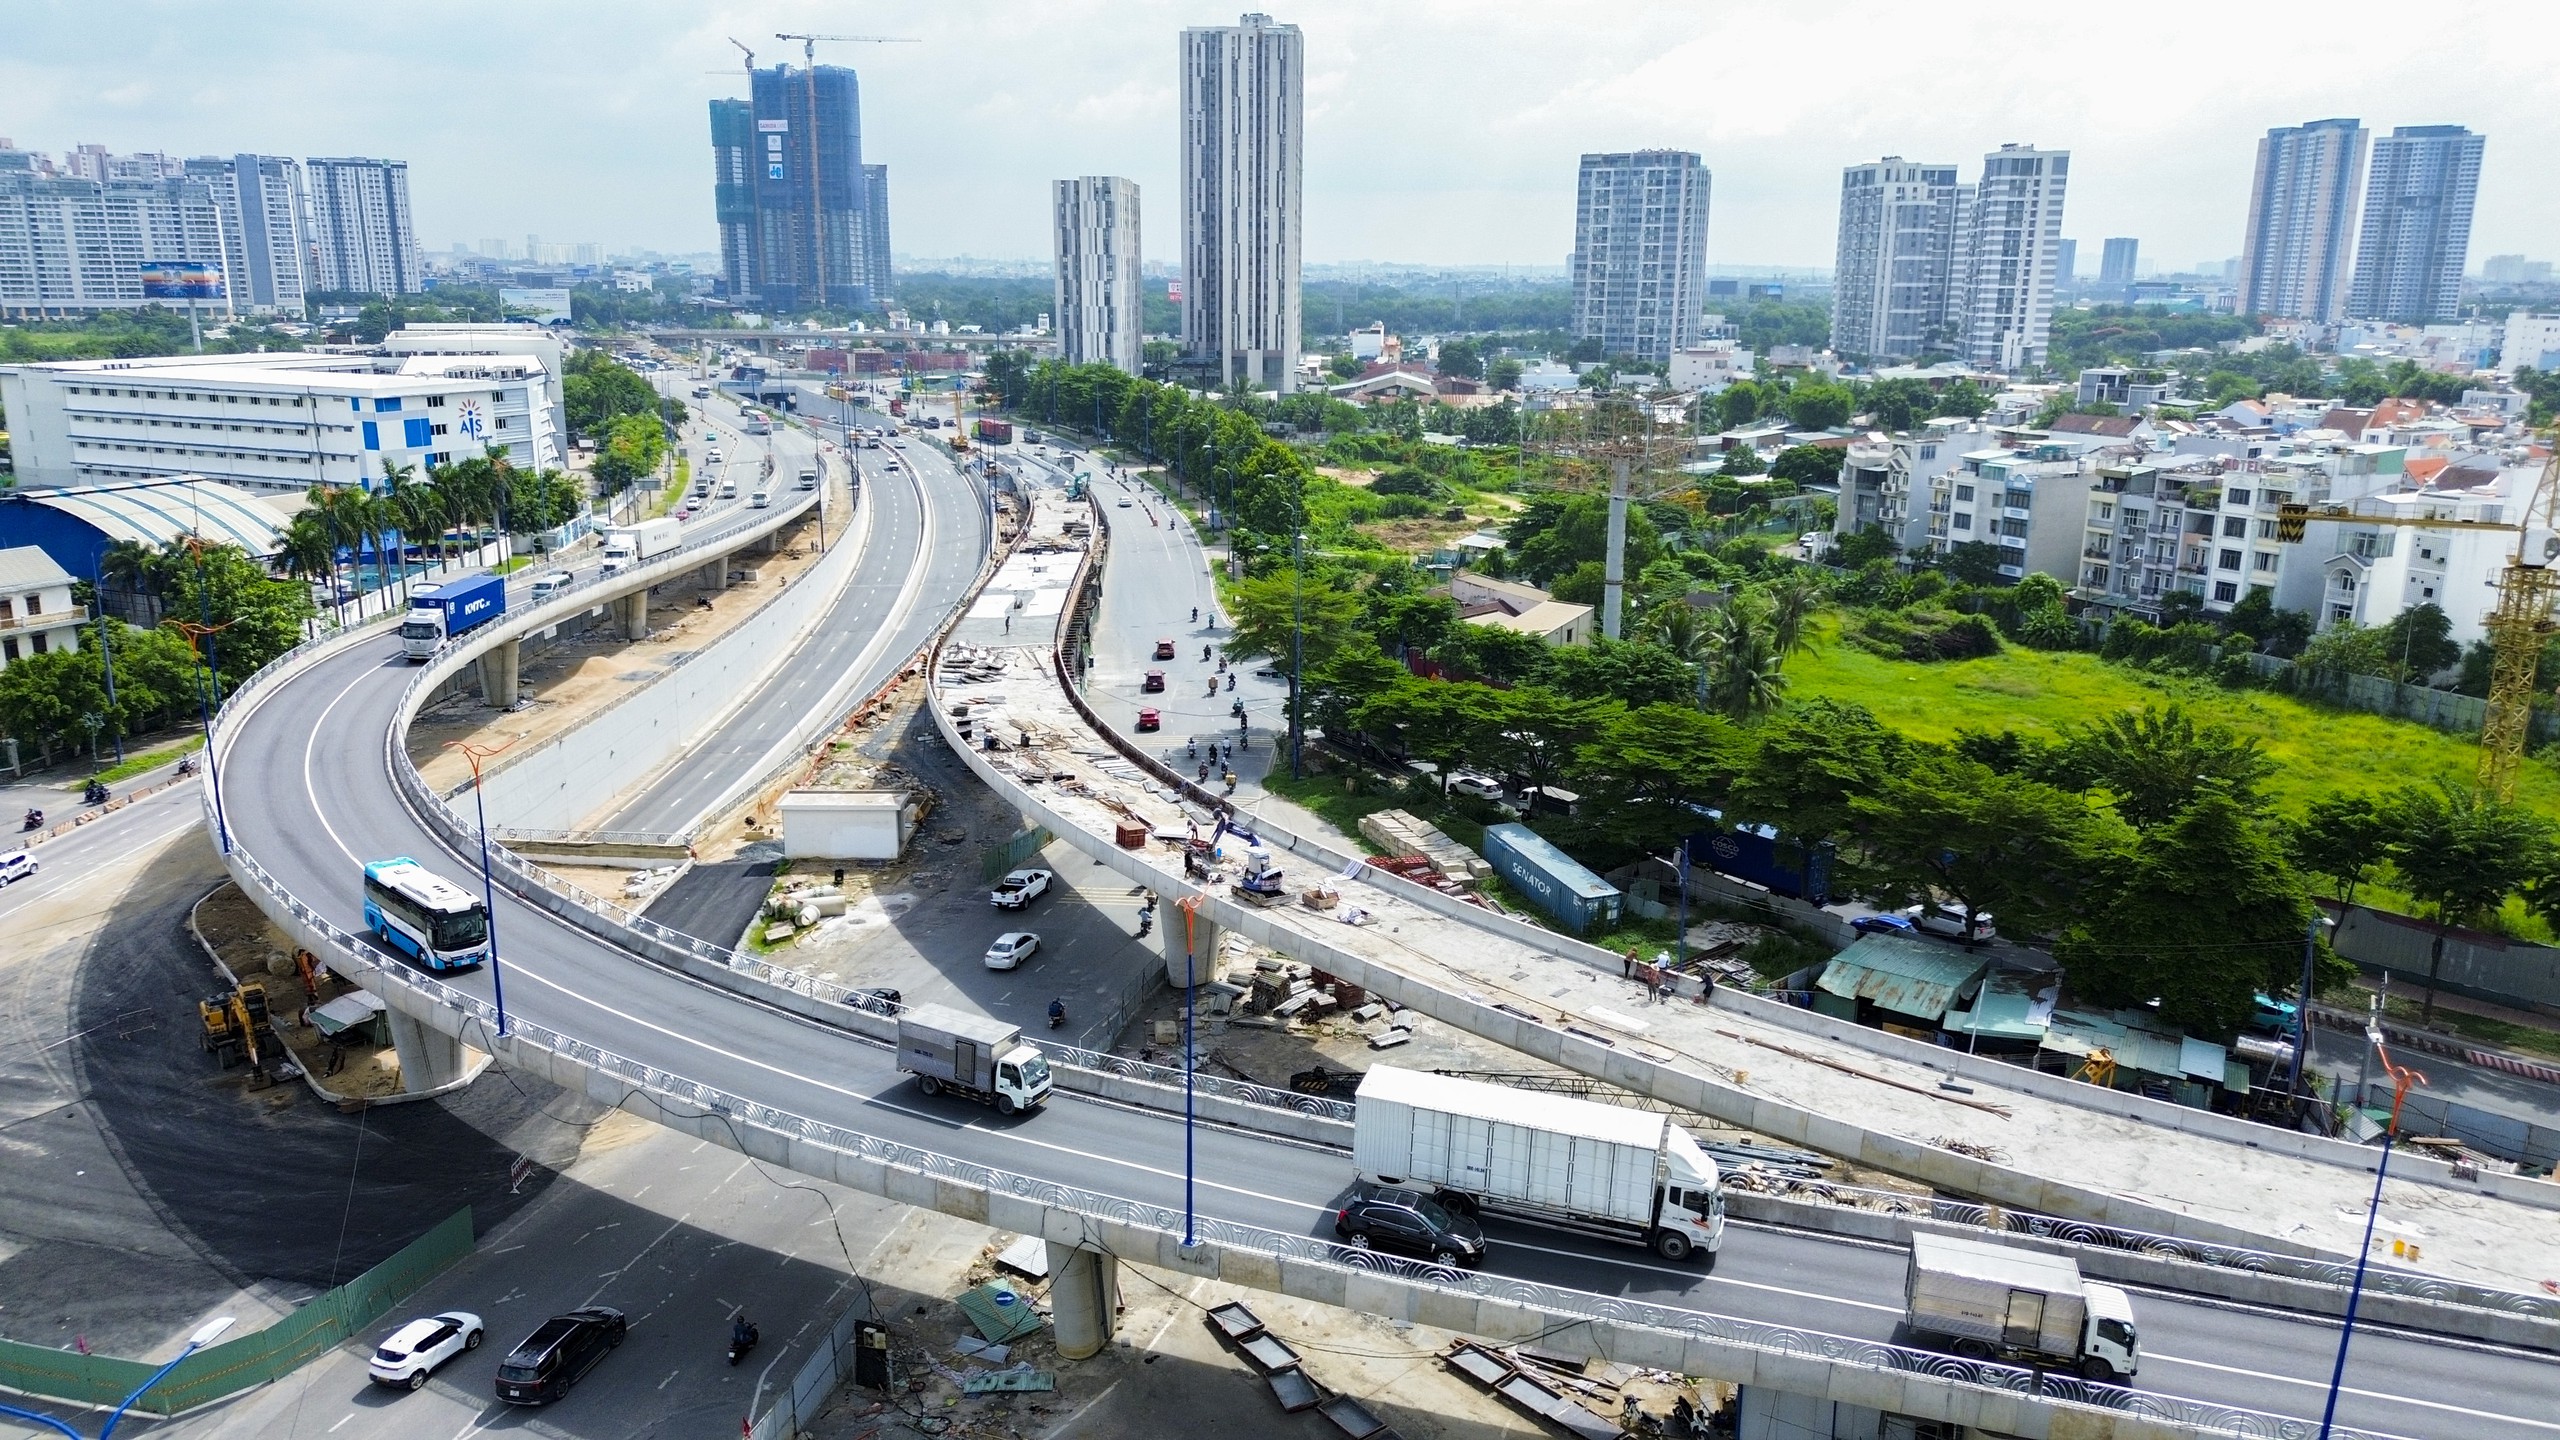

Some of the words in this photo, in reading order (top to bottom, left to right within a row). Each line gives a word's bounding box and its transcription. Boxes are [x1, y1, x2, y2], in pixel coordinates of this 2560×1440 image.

[2224, 458, 2261, 474] HOTEL
[464, 597, 485, 616] KMTC
[1711, 839, 1740, 852] COSCO
[1512, 862, 1552, 897] SENATOR
